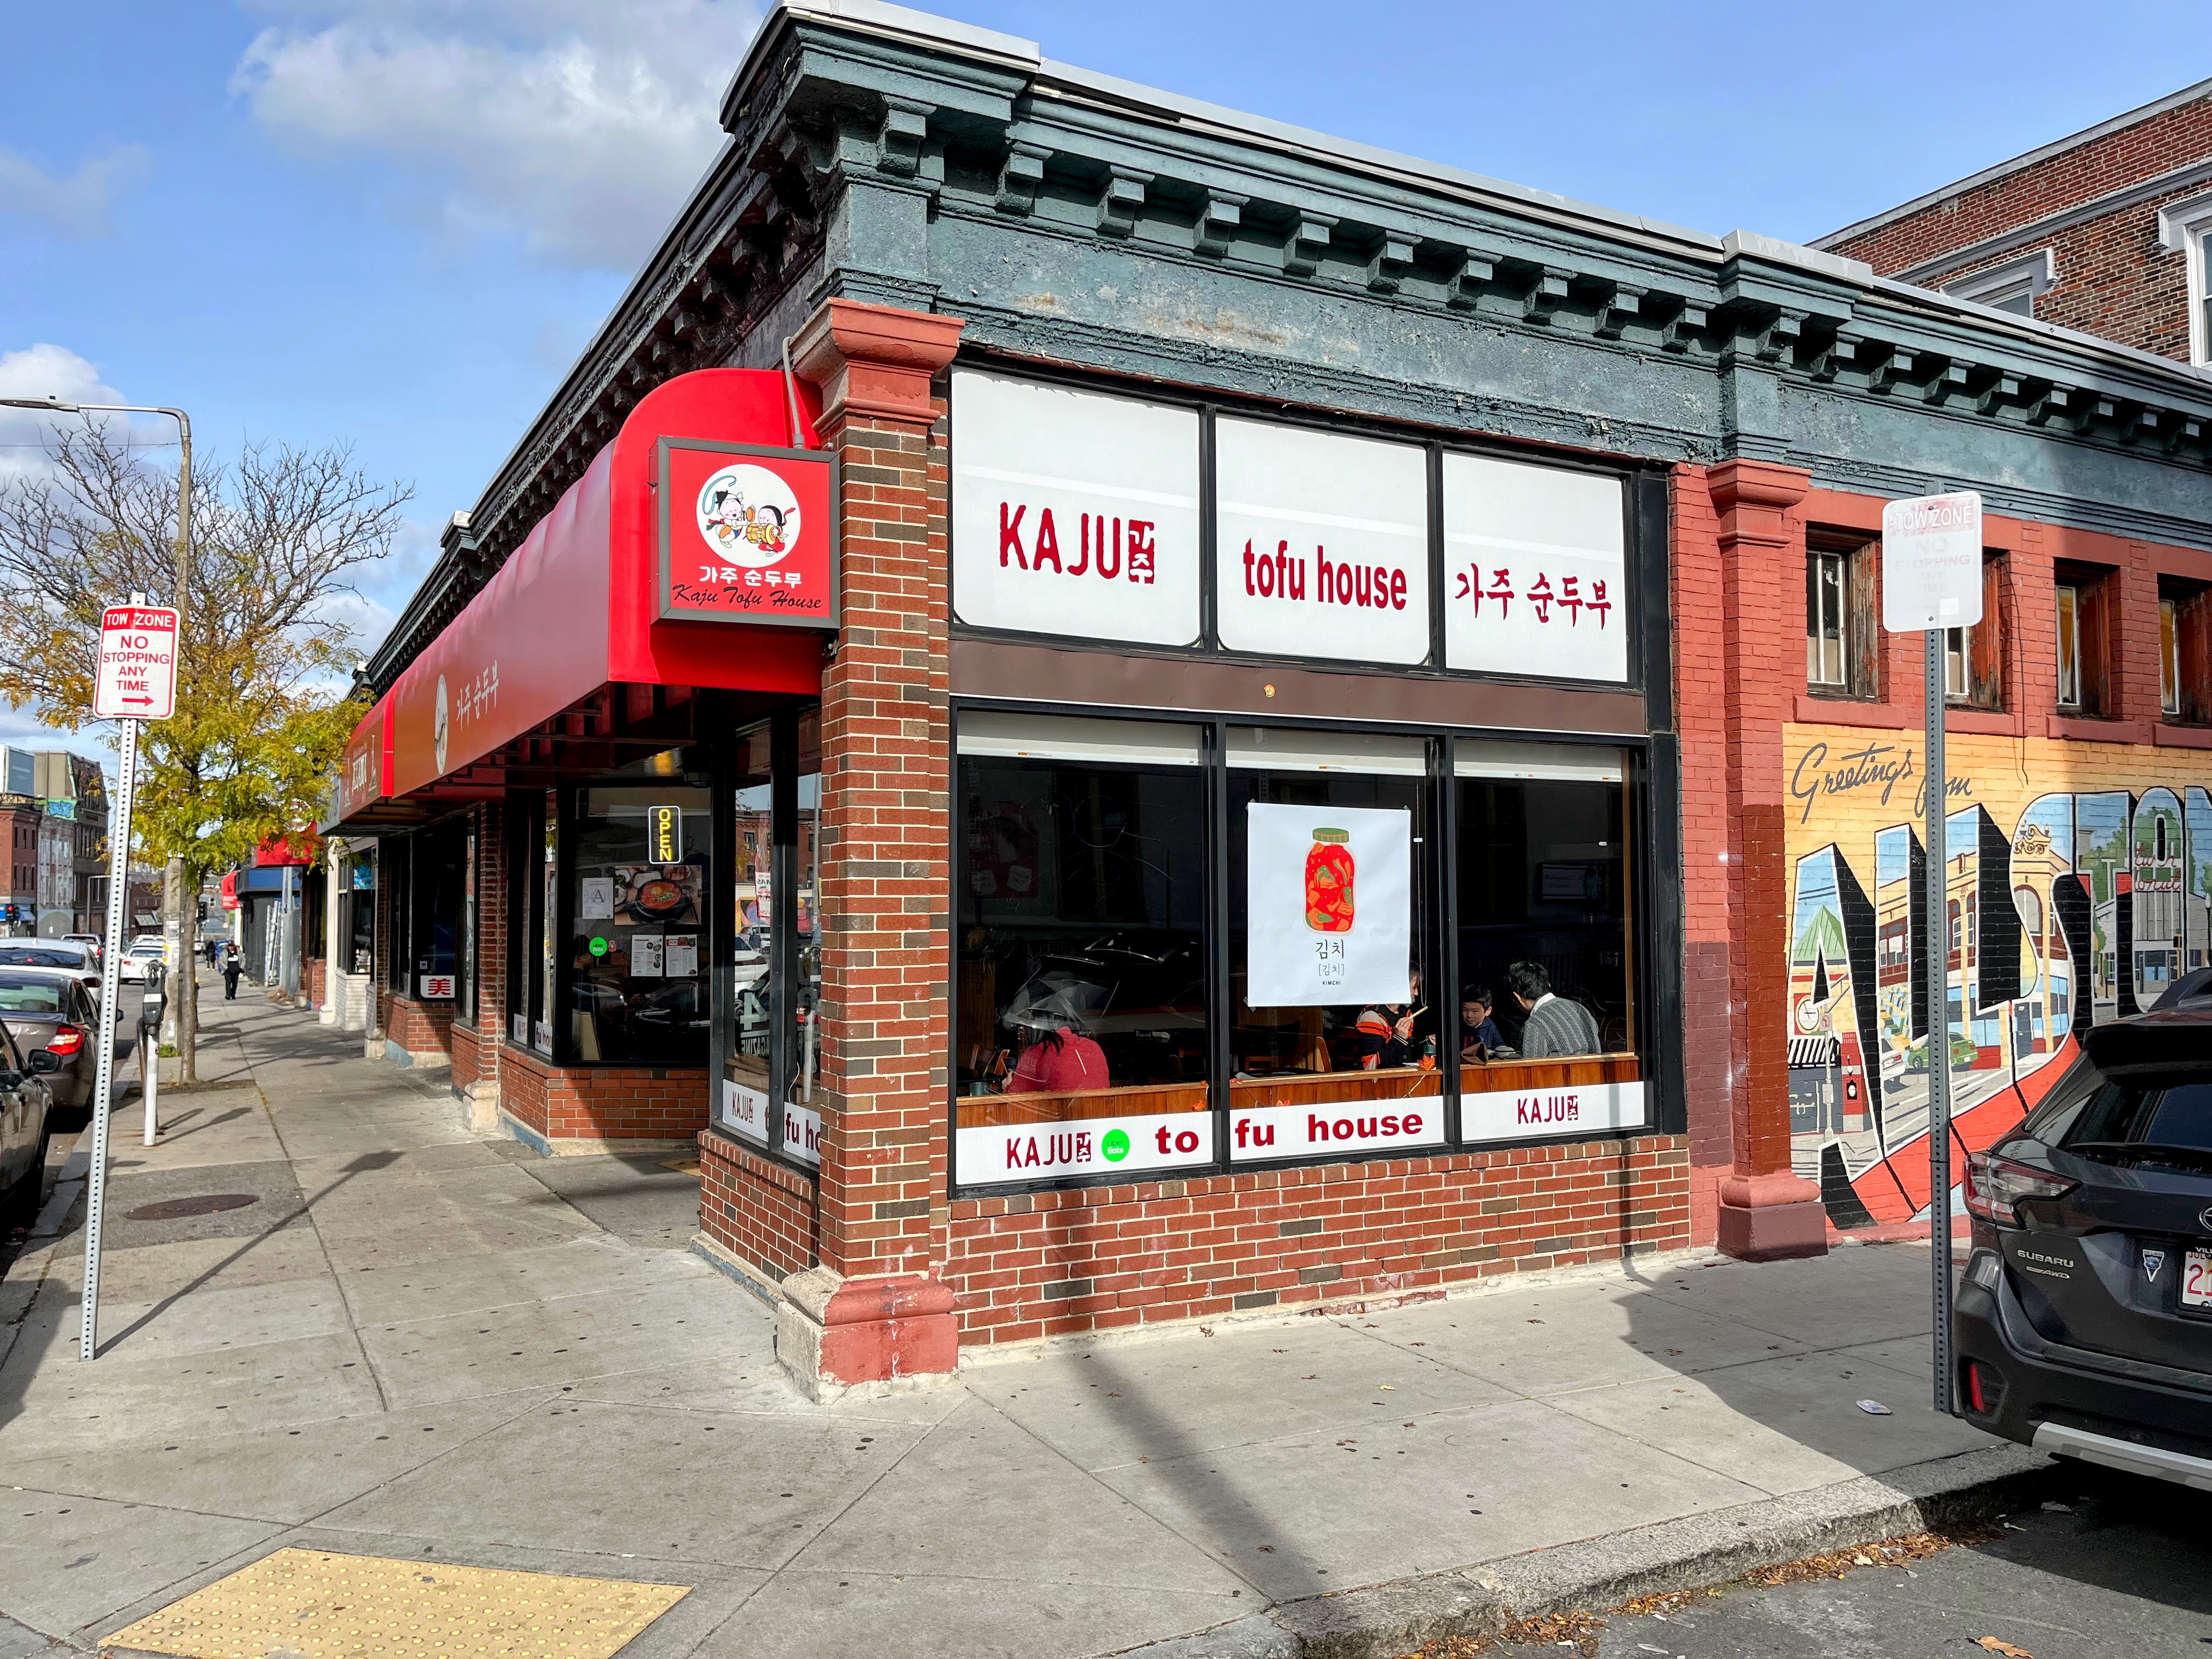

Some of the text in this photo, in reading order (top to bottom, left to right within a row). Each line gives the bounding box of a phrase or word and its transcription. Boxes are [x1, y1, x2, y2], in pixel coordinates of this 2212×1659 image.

[1896, 505, 1973, 531] TOW ZONE
[1000, 502, 1121, 580] KAJU
[699, 566, 738, 584] 가주
[1243, 538, 1407, 611] tofu house
[1895, 555, 1970, 570] SOPPING
[672, 584, 822, 609] Kaju Tofu House
[1455, 563, 1612, 630] 가주 순두부
[106, 613, 173, 628] TOW ZONE
[121, 635, 149, 649] NO
[103, 652, 170, 664] STOPPING
[118, 666, 148, 676] ANY
[116, 680, 149, 692] TIME
[456, 659, 499, 732] 가주 순두부
[1792, 742, 1914, 825] Greetings
[658, 808, 673, 862] OPEN
[593, 889, 605, 903] A
[1315, 939, 1345, 960] 김치
[428, 979, 451, 995] 美
[732, 1091, 748, 1122] KAJU
[1517, 1097, 1566, 1124] KAJU
[786, 1113, 800, 1145] fu
[1155, 1114, 1423, 1154] to fu house
[1007, 1133, 1073, 1169] KAJU
[2017, 1250, 2074, 1268] SUBARU
